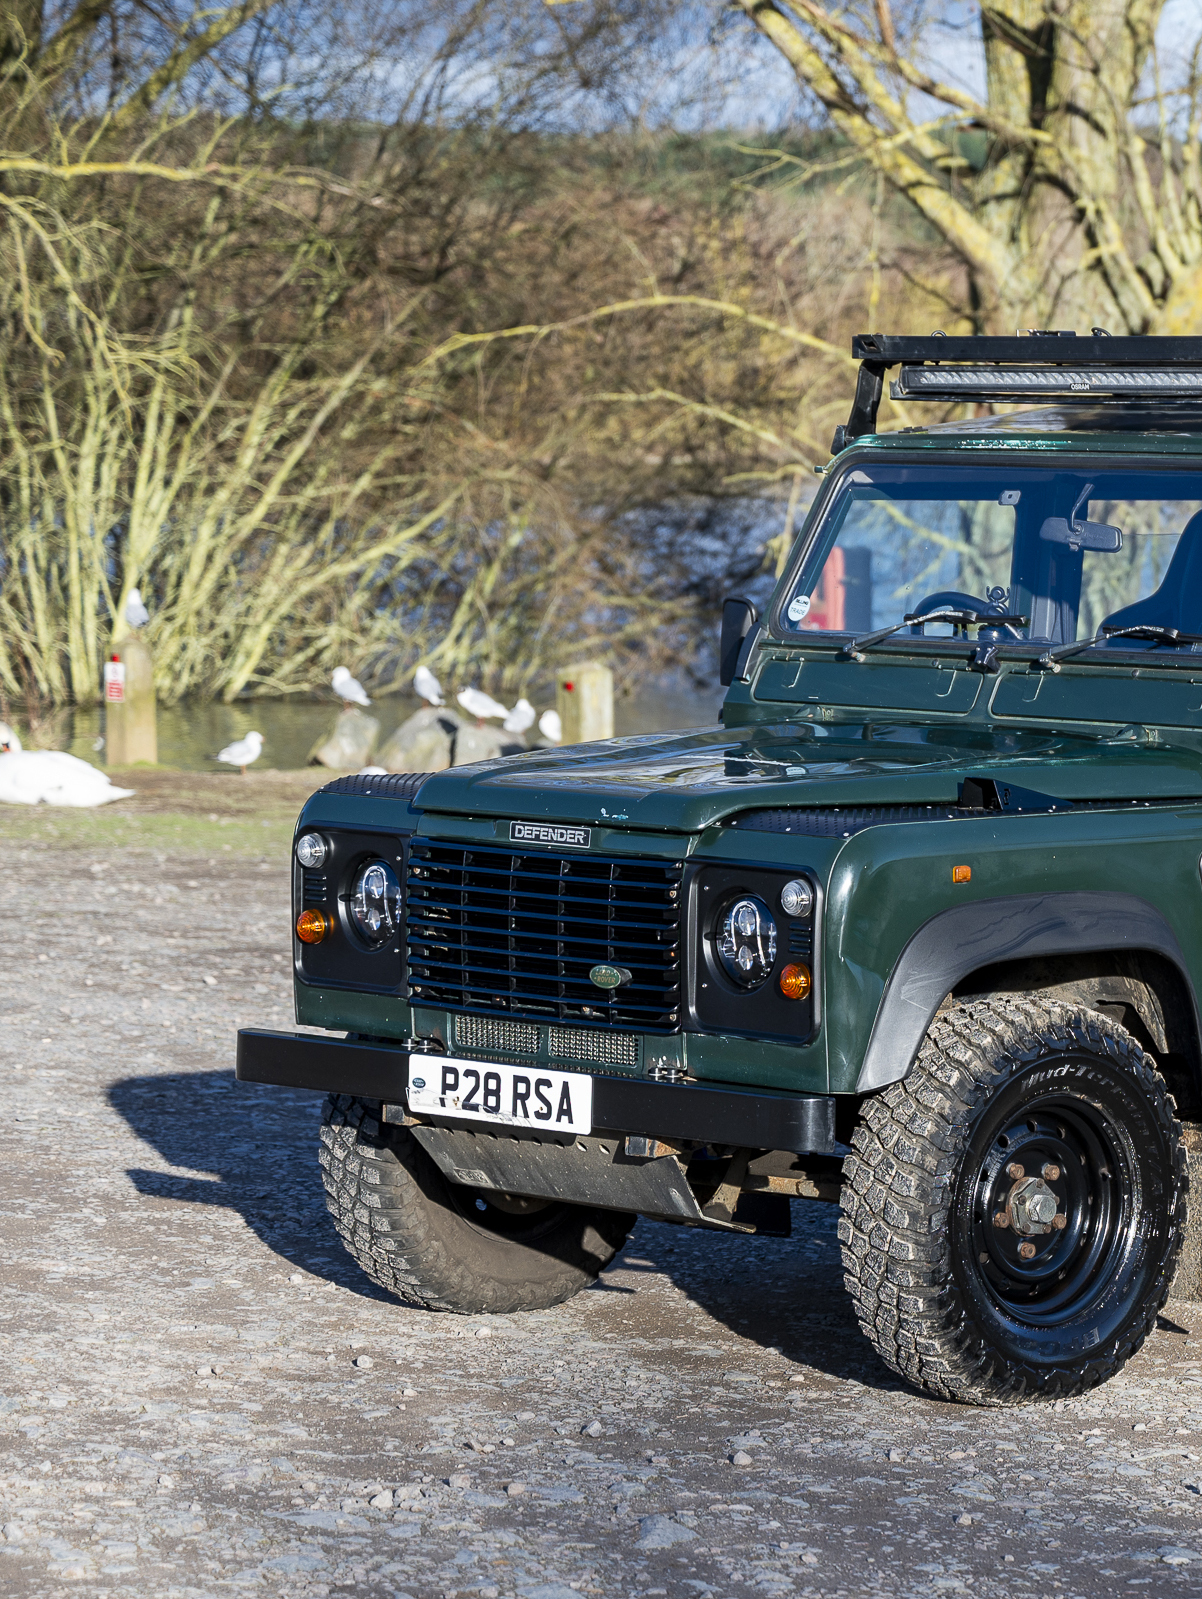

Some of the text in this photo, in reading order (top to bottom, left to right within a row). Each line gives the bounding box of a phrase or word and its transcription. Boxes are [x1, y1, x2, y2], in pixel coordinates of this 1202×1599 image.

[514, 824, 585, 844] DEFENDER
[596, 976, 616, 984] ROVER
[438, 1065, 574, 1125] P28 RSA
